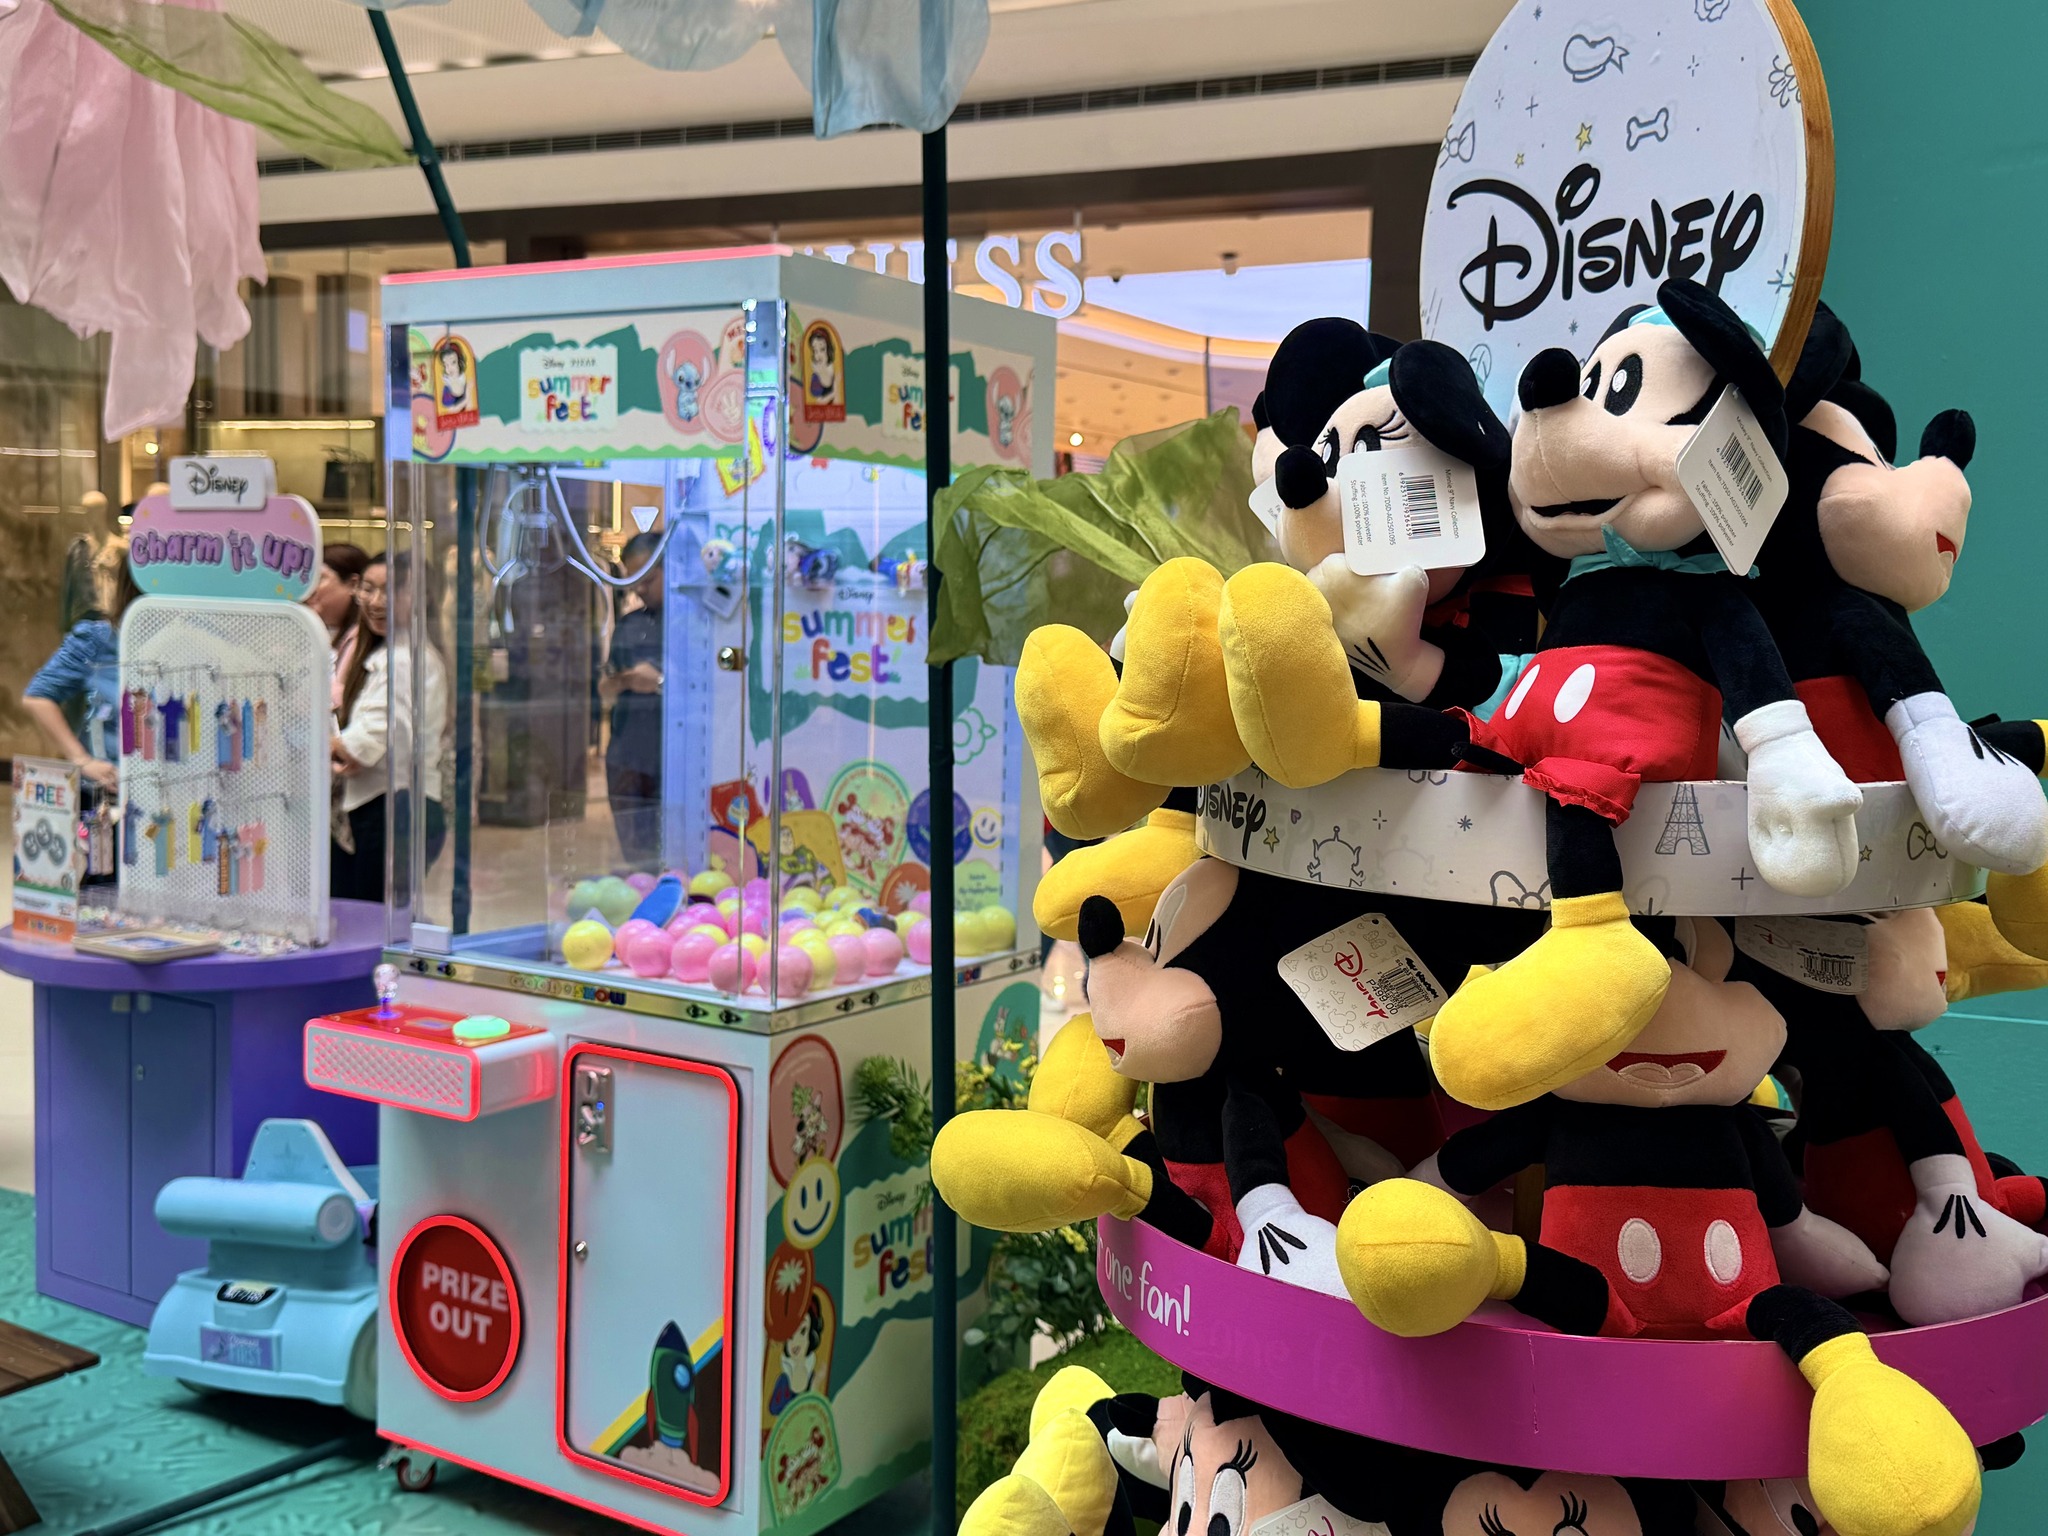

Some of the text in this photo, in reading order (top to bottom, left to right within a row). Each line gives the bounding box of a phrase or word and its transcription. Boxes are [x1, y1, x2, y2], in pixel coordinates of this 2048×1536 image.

[1447, 163, 1763, 331] Disney
[527, 375, 611, 399] summer
[546, 394, 591, 421] fest
[888, 383, 926, 409] sum
[186, 461, 248, 503] Disney
[1349, 479, 1358, 501] Stuffing
[1354, 520, 1364, 546] polyester
[1358, 480, 1367, 497] Fabric
[1363, 516, 1372, 542] polyester
[1451, 511, 1460, 538] Collection
[783, 609, 915, 645] summer
[811, 638, 889, 684] fest
[25, 785, 65, 807] FREE
[1365, 977, 1398, 1016] P499.00
[422, 1260, 509, 1312] PRIZE
[1105, 1250, 1132, 1301] one
[1138, 1261, 1191, 1336] fan!
[429, 1301, 492, 1345] OUT
